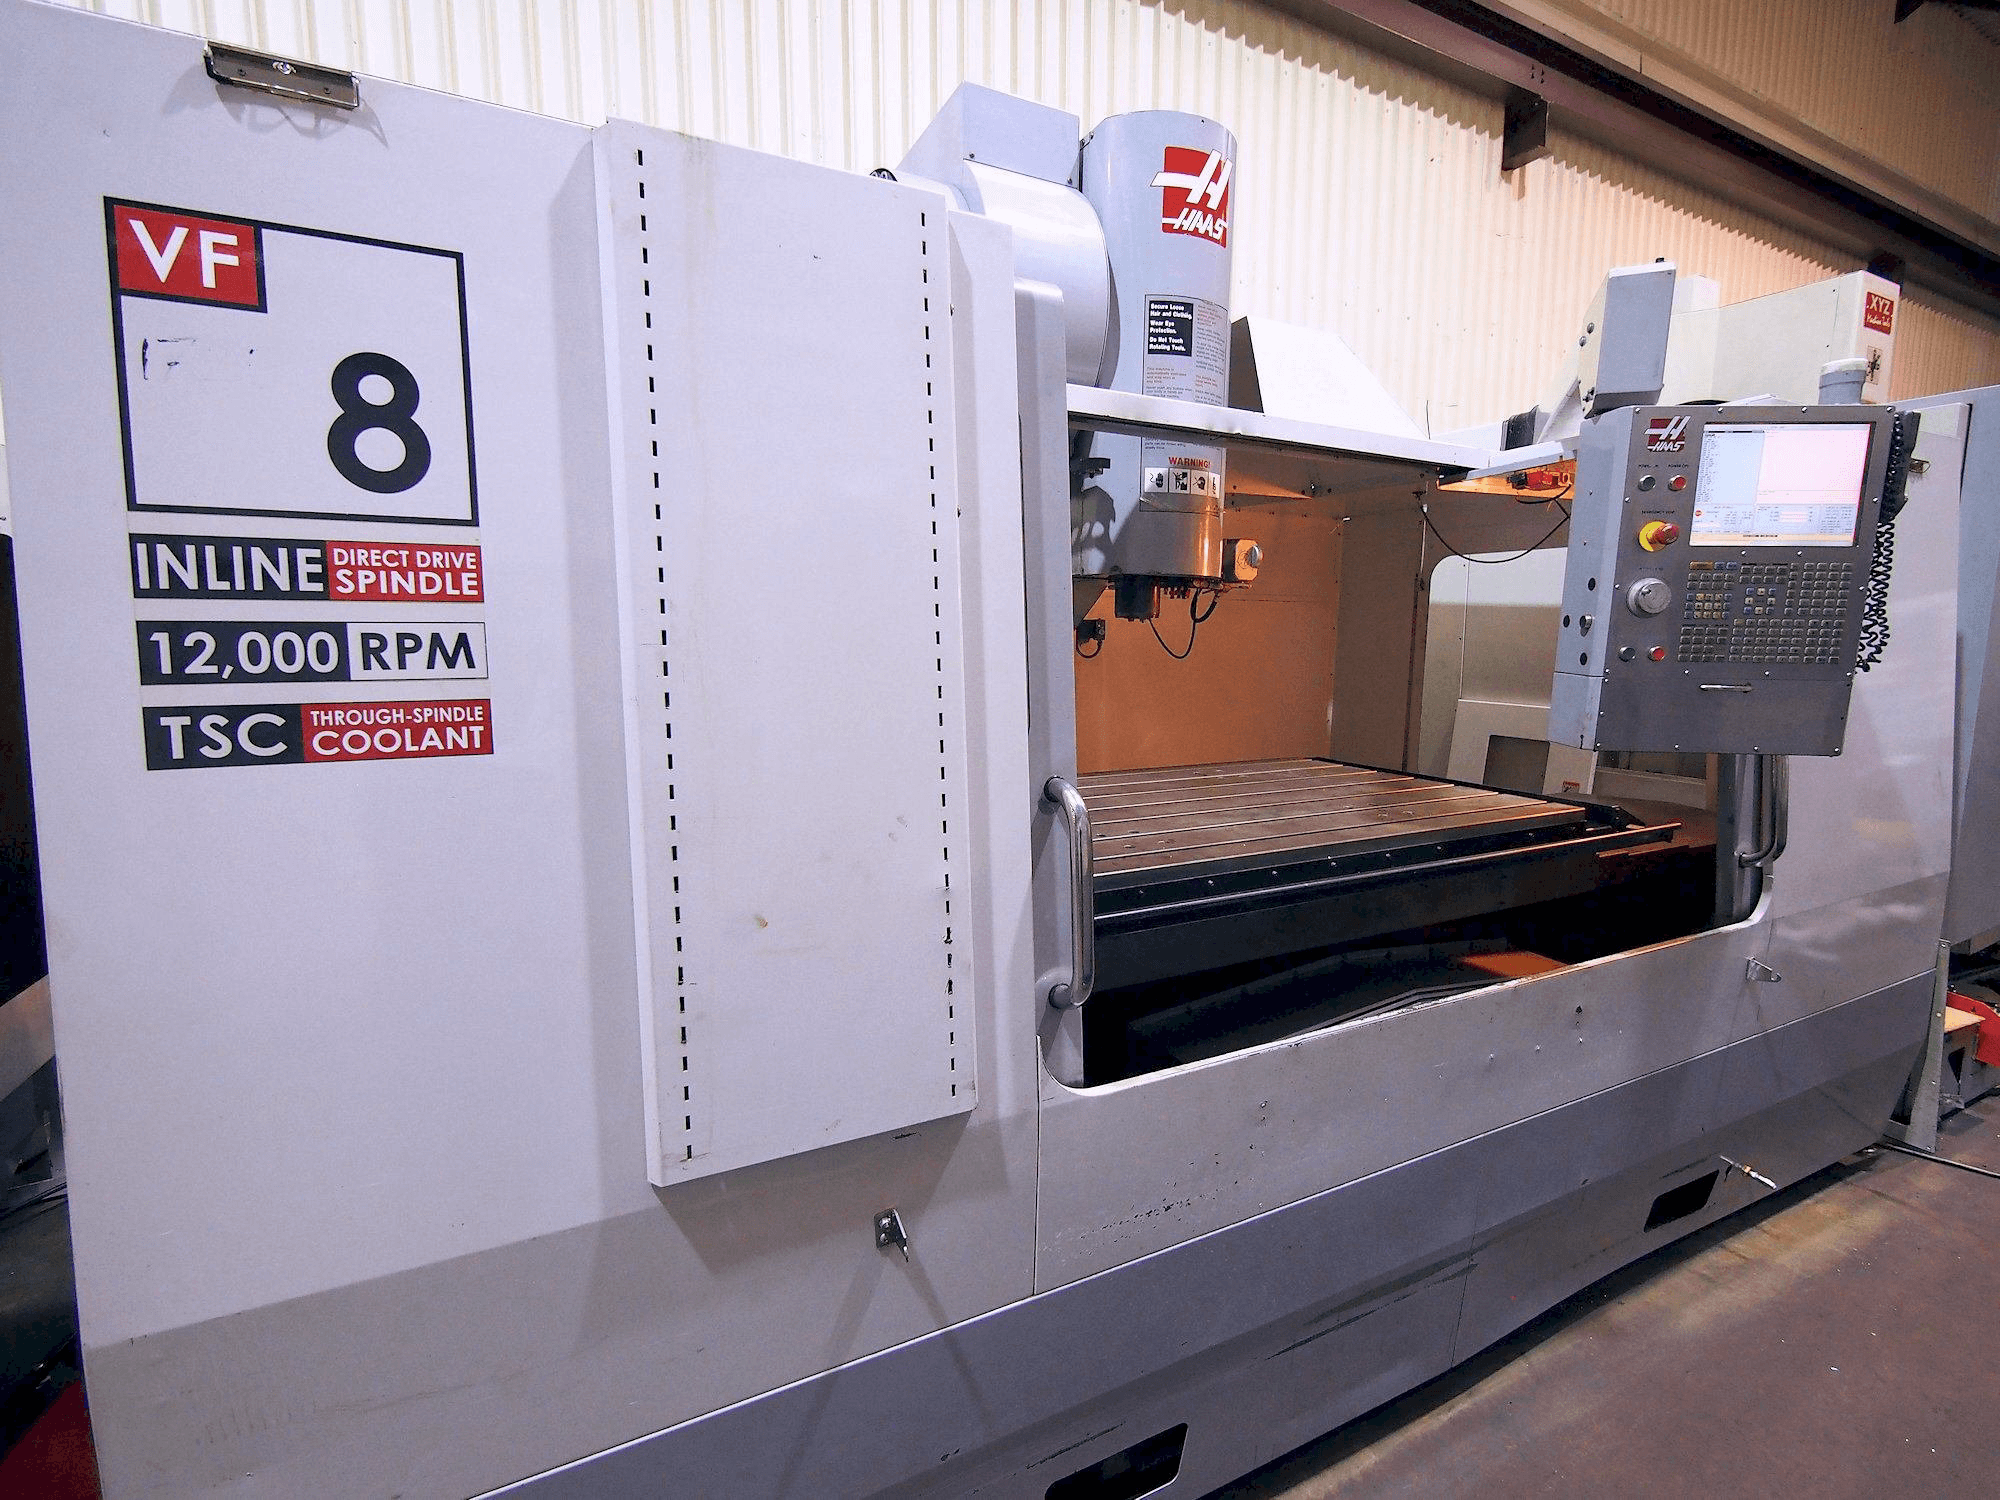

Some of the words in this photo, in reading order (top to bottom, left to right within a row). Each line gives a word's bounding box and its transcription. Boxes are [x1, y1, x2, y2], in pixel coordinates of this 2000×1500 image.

[1162, 208, 1227, 240] HAAS
[129, 219, 240, 288] VF
[1869, 294, 1891, 315] XYZ
[327, 352, 432, 494] 8
[1168, 456, 1211, 468] WARNING!
[1647, 441, 1685, 452] HAAS
[136, 542, 324, 592] INLINE
[333, 548, 409, 568] DIRECT
[416, 550, 477, 570] DRIVE
[336, 568, 479, 596] SPINDLE
[150, 631, 339, 680] 12,000
[361, 632, 476, 671] RPM
[310, 705, 484, 727] THROUGH-SPINDLE
[160, 713, 288, 760] TSC
[312, 726, 485, 756] COOLANT
